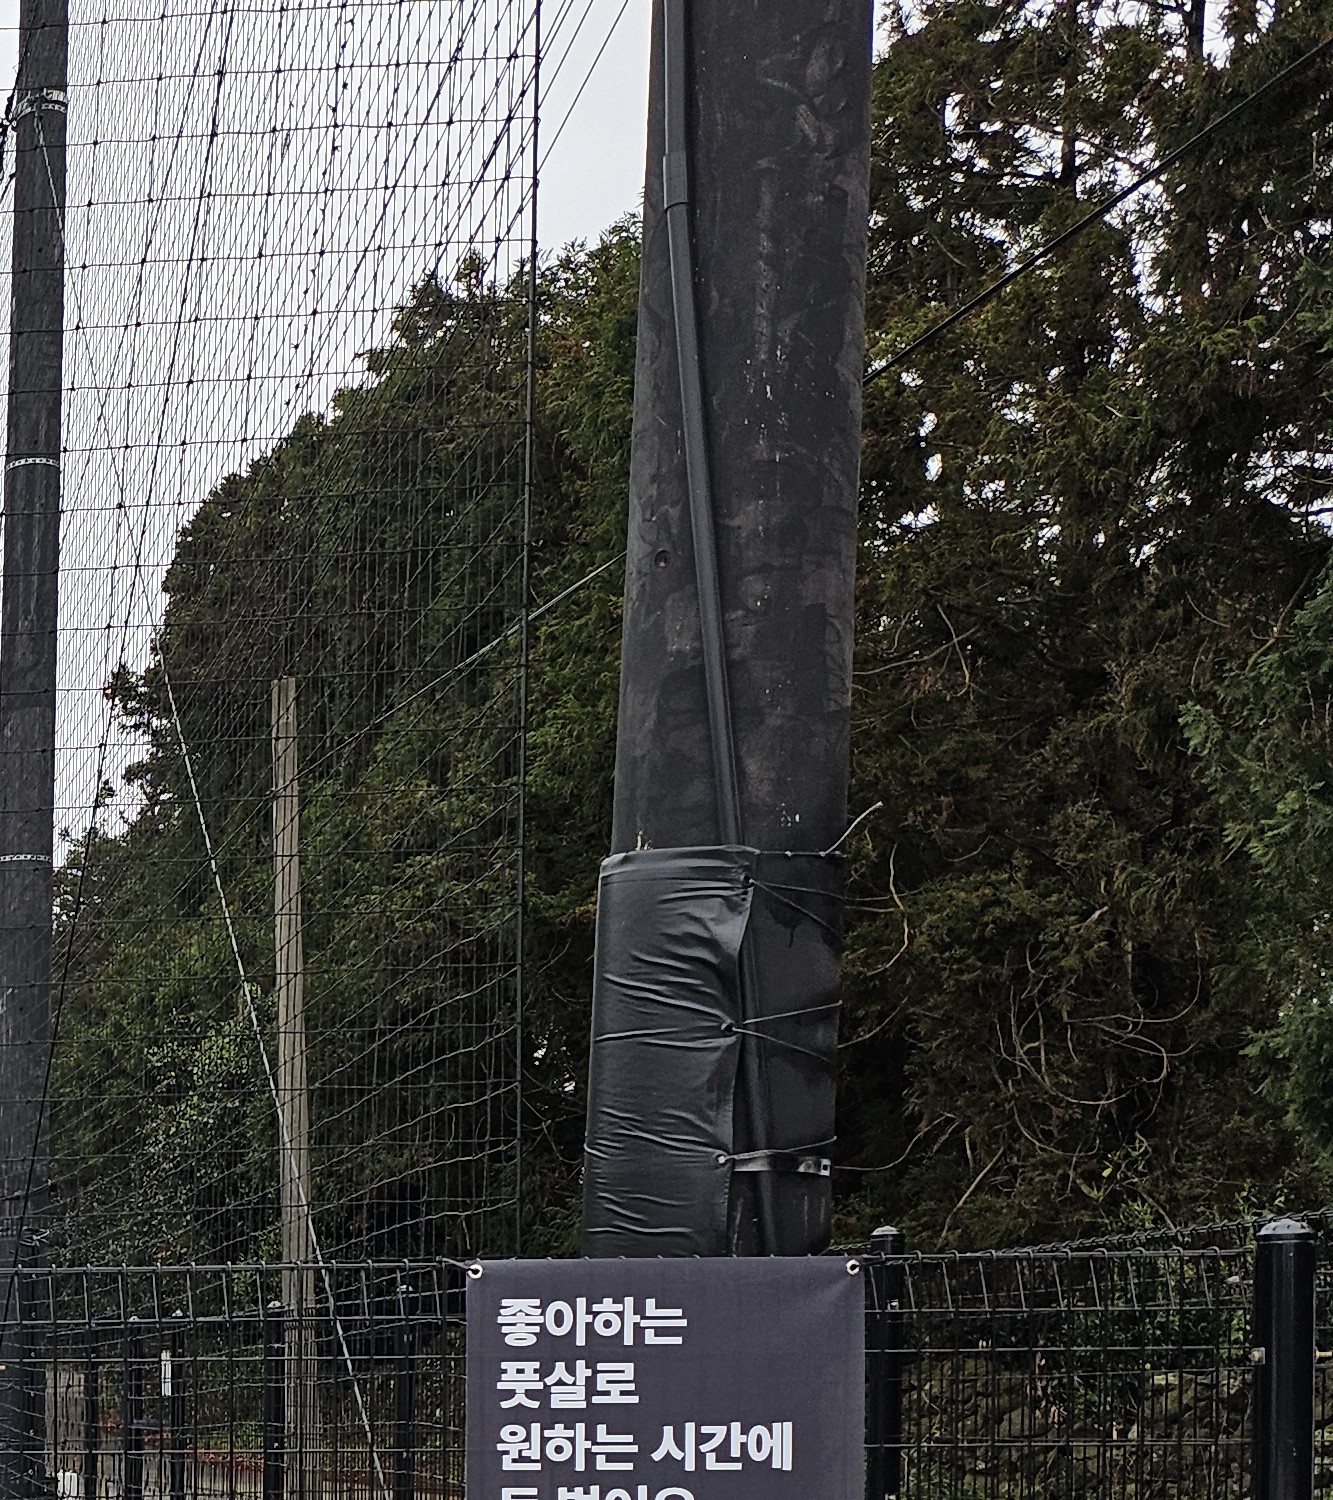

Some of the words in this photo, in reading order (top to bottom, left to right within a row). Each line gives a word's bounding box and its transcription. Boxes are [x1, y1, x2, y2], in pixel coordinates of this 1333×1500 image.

[496, 1297, 688, 1346] 좋아하는
[496, 1360, 639, 1409] 풋살로
[496, 1423, 639, 1471] 원하는
[650, 1421, 793, 1471] 시간에
